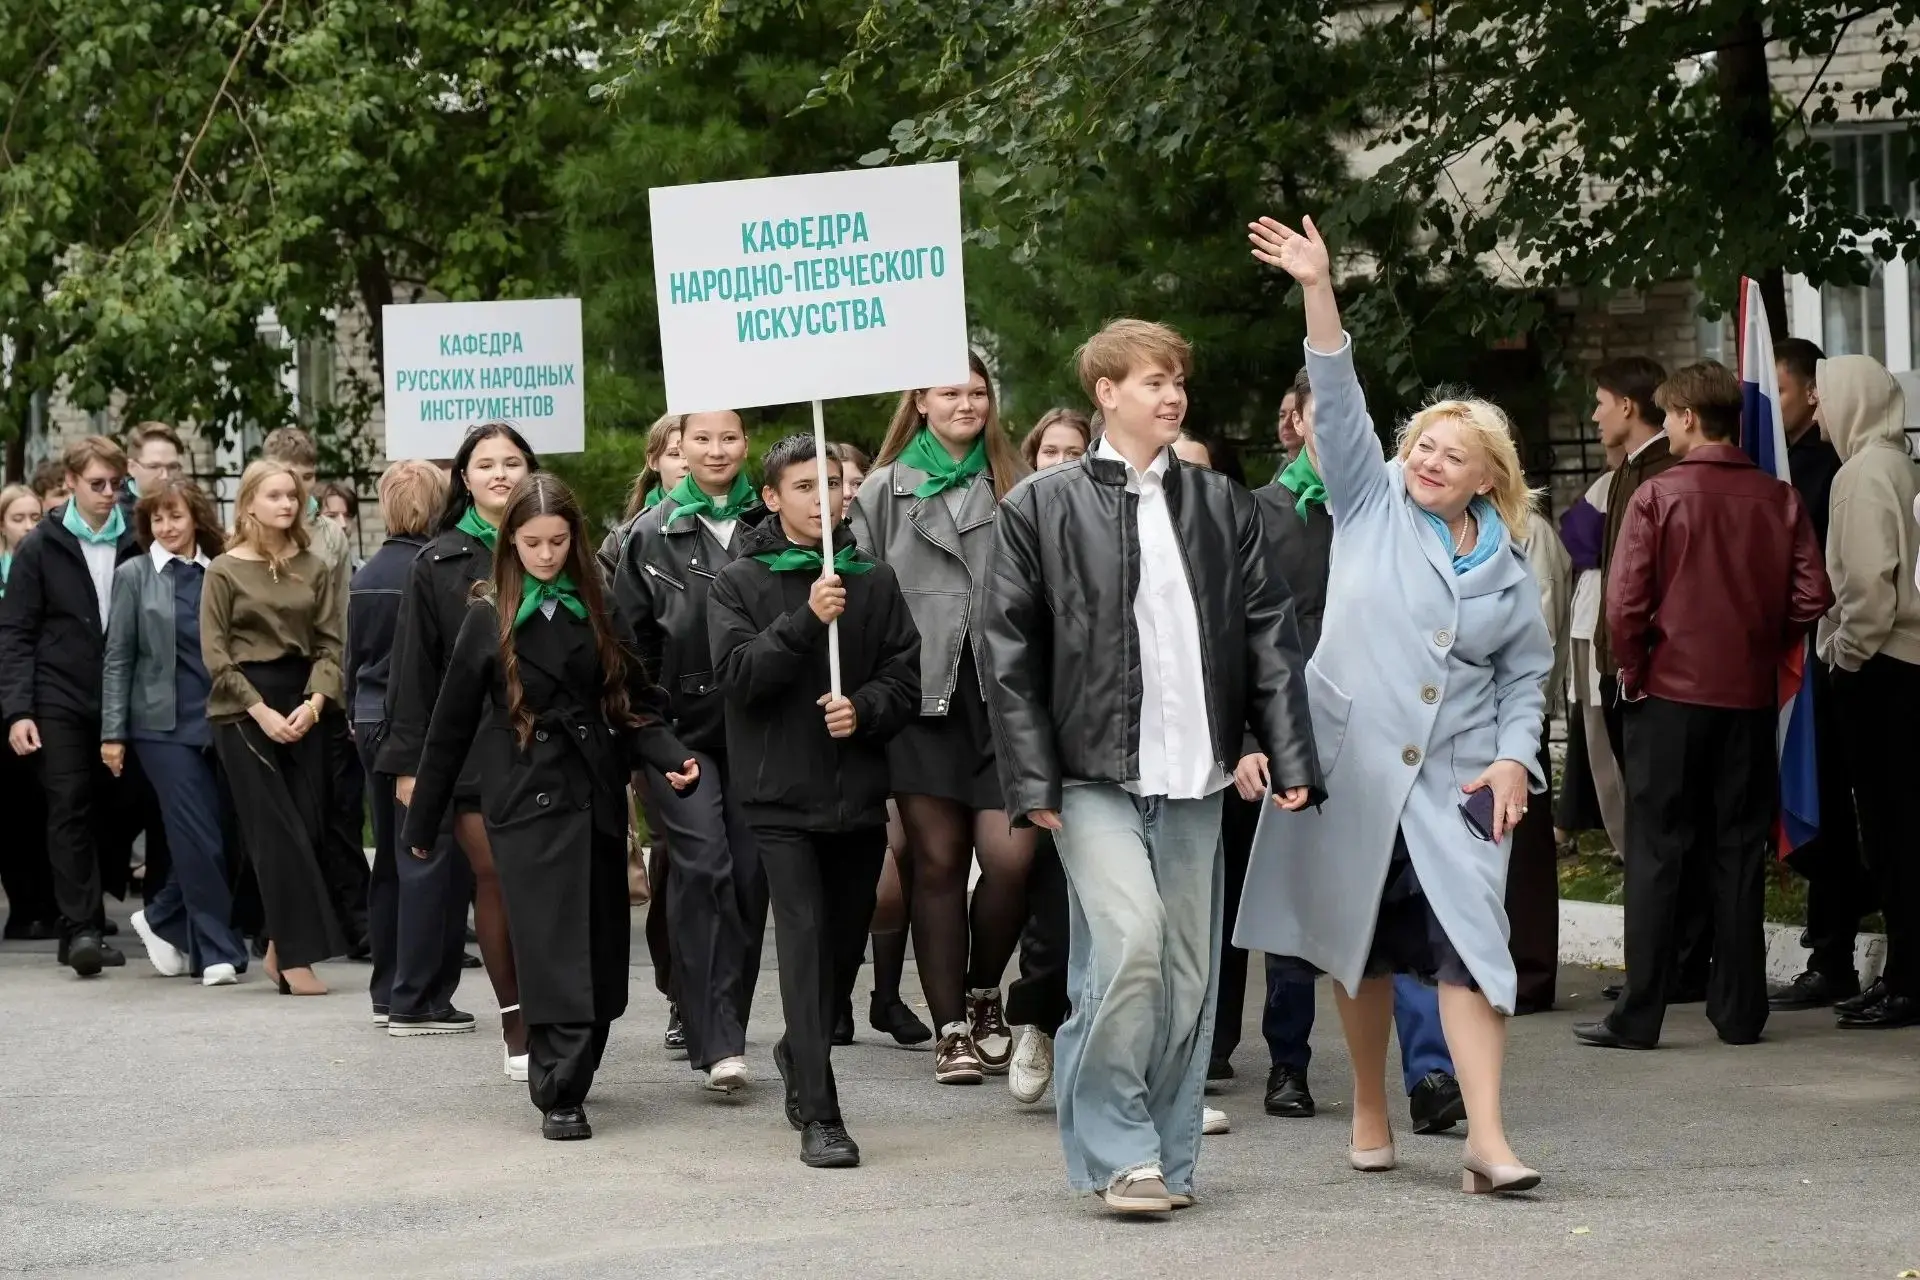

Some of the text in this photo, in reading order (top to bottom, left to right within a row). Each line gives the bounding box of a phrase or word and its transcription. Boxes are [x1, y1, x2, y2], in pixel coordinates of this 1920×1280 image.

[741, 211, 869, 254] КАФЕДРА
[669, 245, 946, 304] НАРОДНО-ПЕВЧЕСКОГО
[736, 296, 886, 342] ИСКУССТВА
[439, 332, 524, 357] КАФЕДРА
[396, 364, 575, 392] РУССКИХ НАРОДНЫХ
[420, 395, 555, 422] ИНСТРУМЕНТОВ
